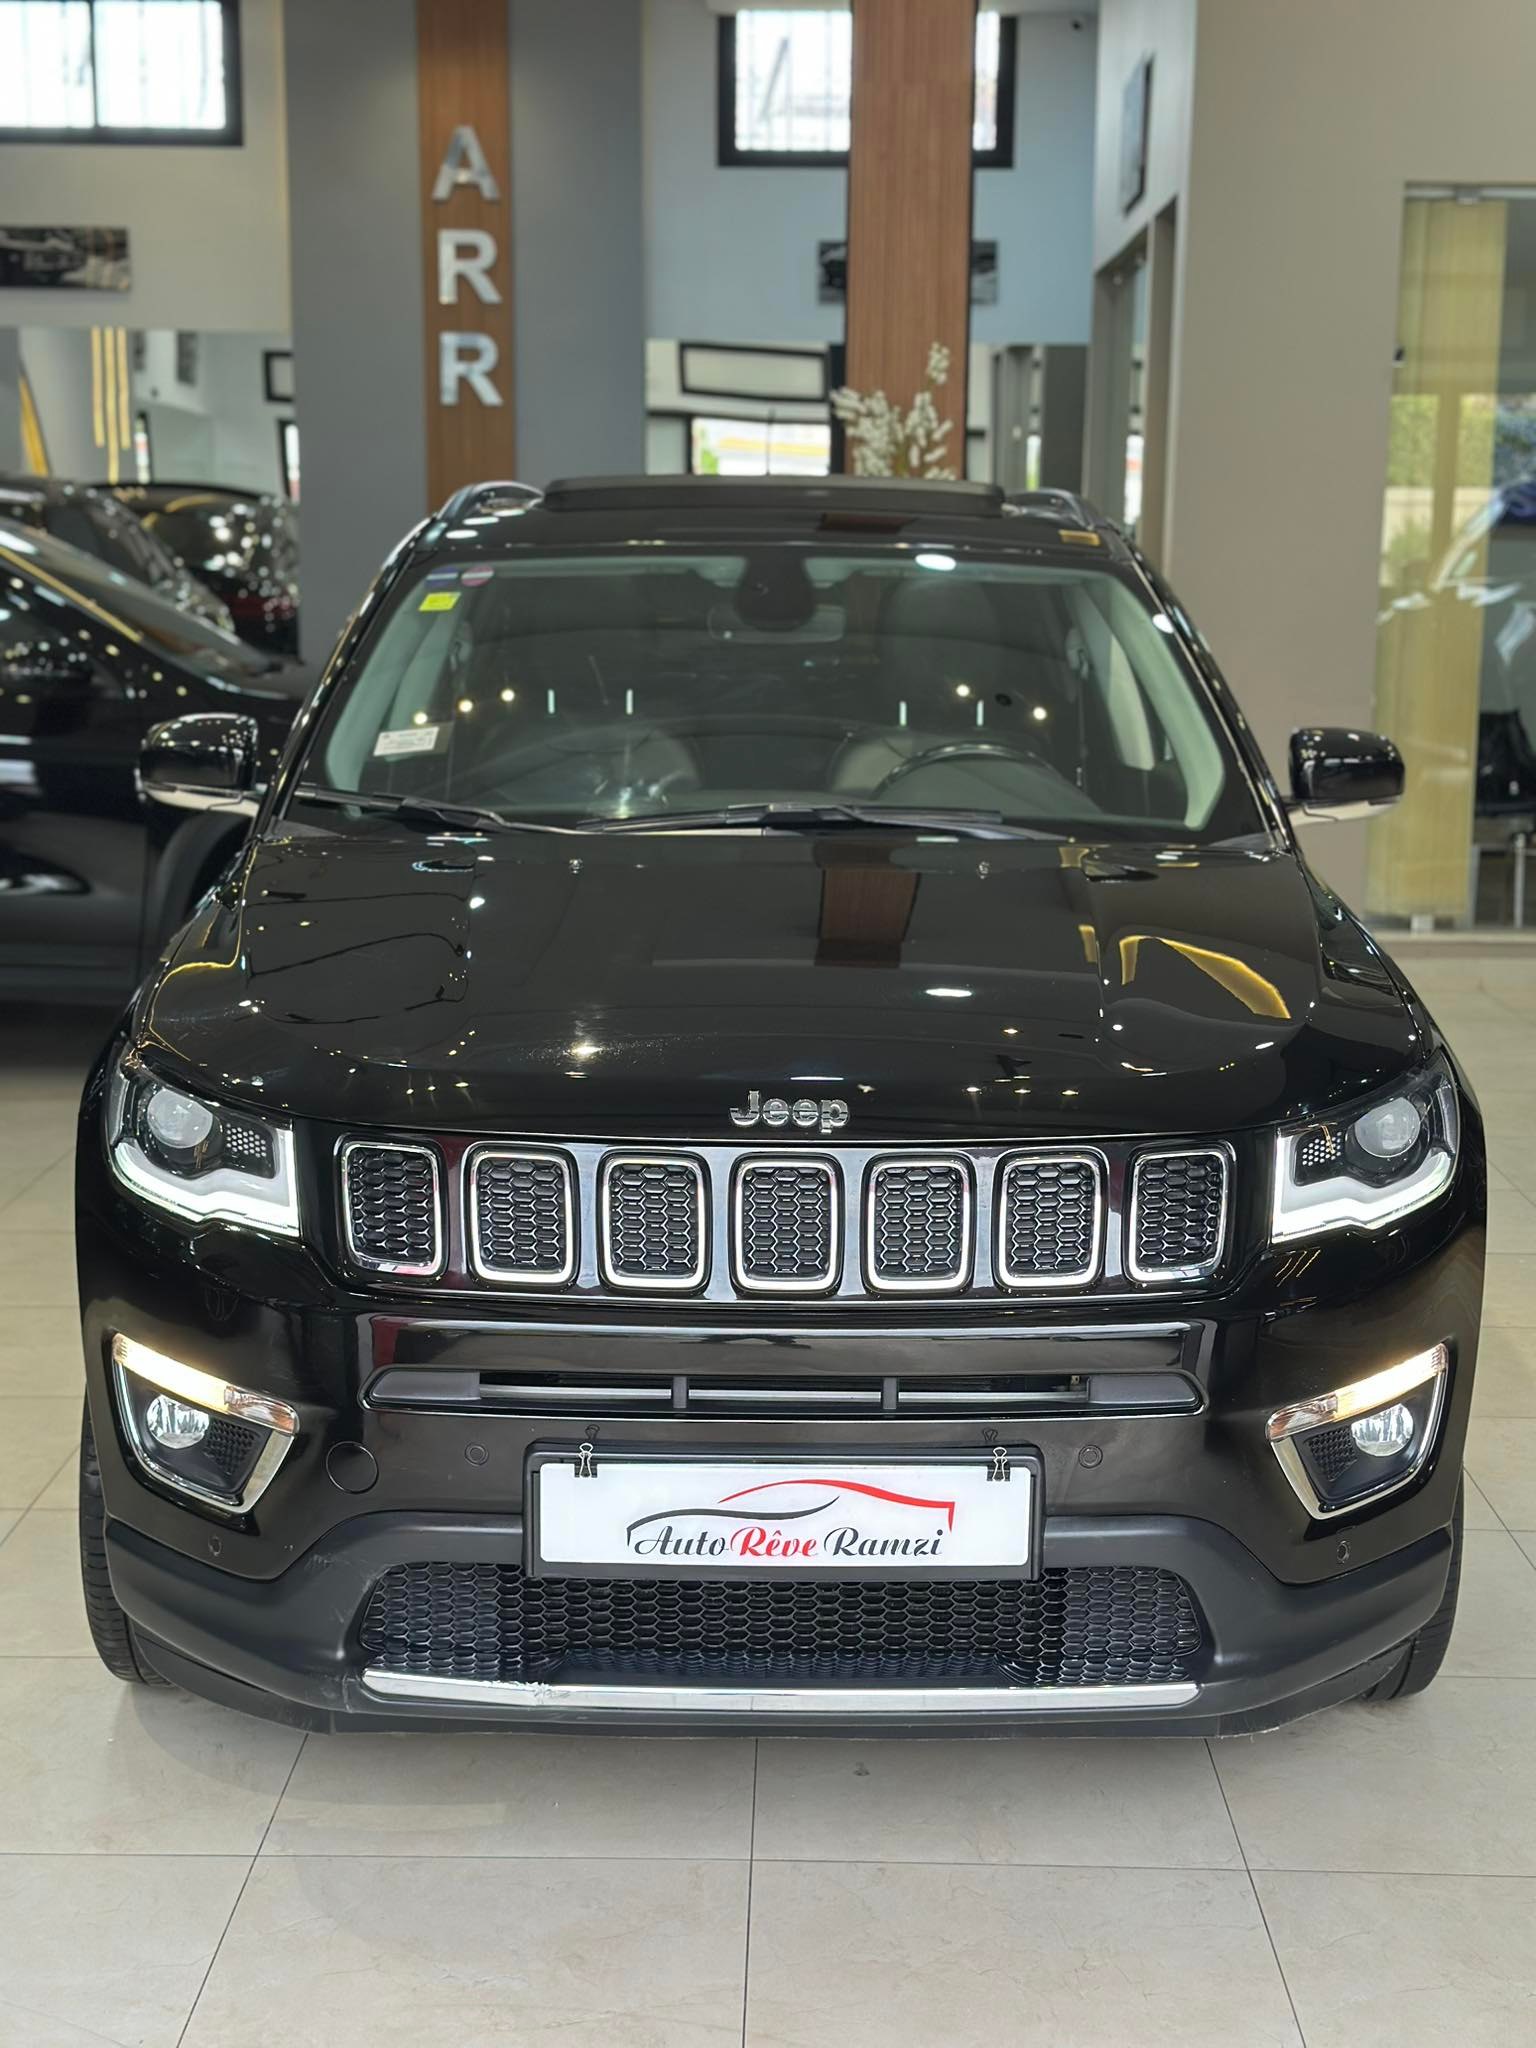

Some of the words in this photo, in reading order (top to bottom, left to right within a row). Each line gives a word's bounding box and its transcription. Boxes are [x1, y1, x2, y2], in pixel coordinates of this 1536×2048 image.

[432, 124, 503, 407] ARR
[729, 1090, 849, 1134] Jeep
[634, 1525, 728, 1557] Auto
[731, 1525, 818, 1557] Rêve
[823, 1526, 944, 1557] Ramzi
